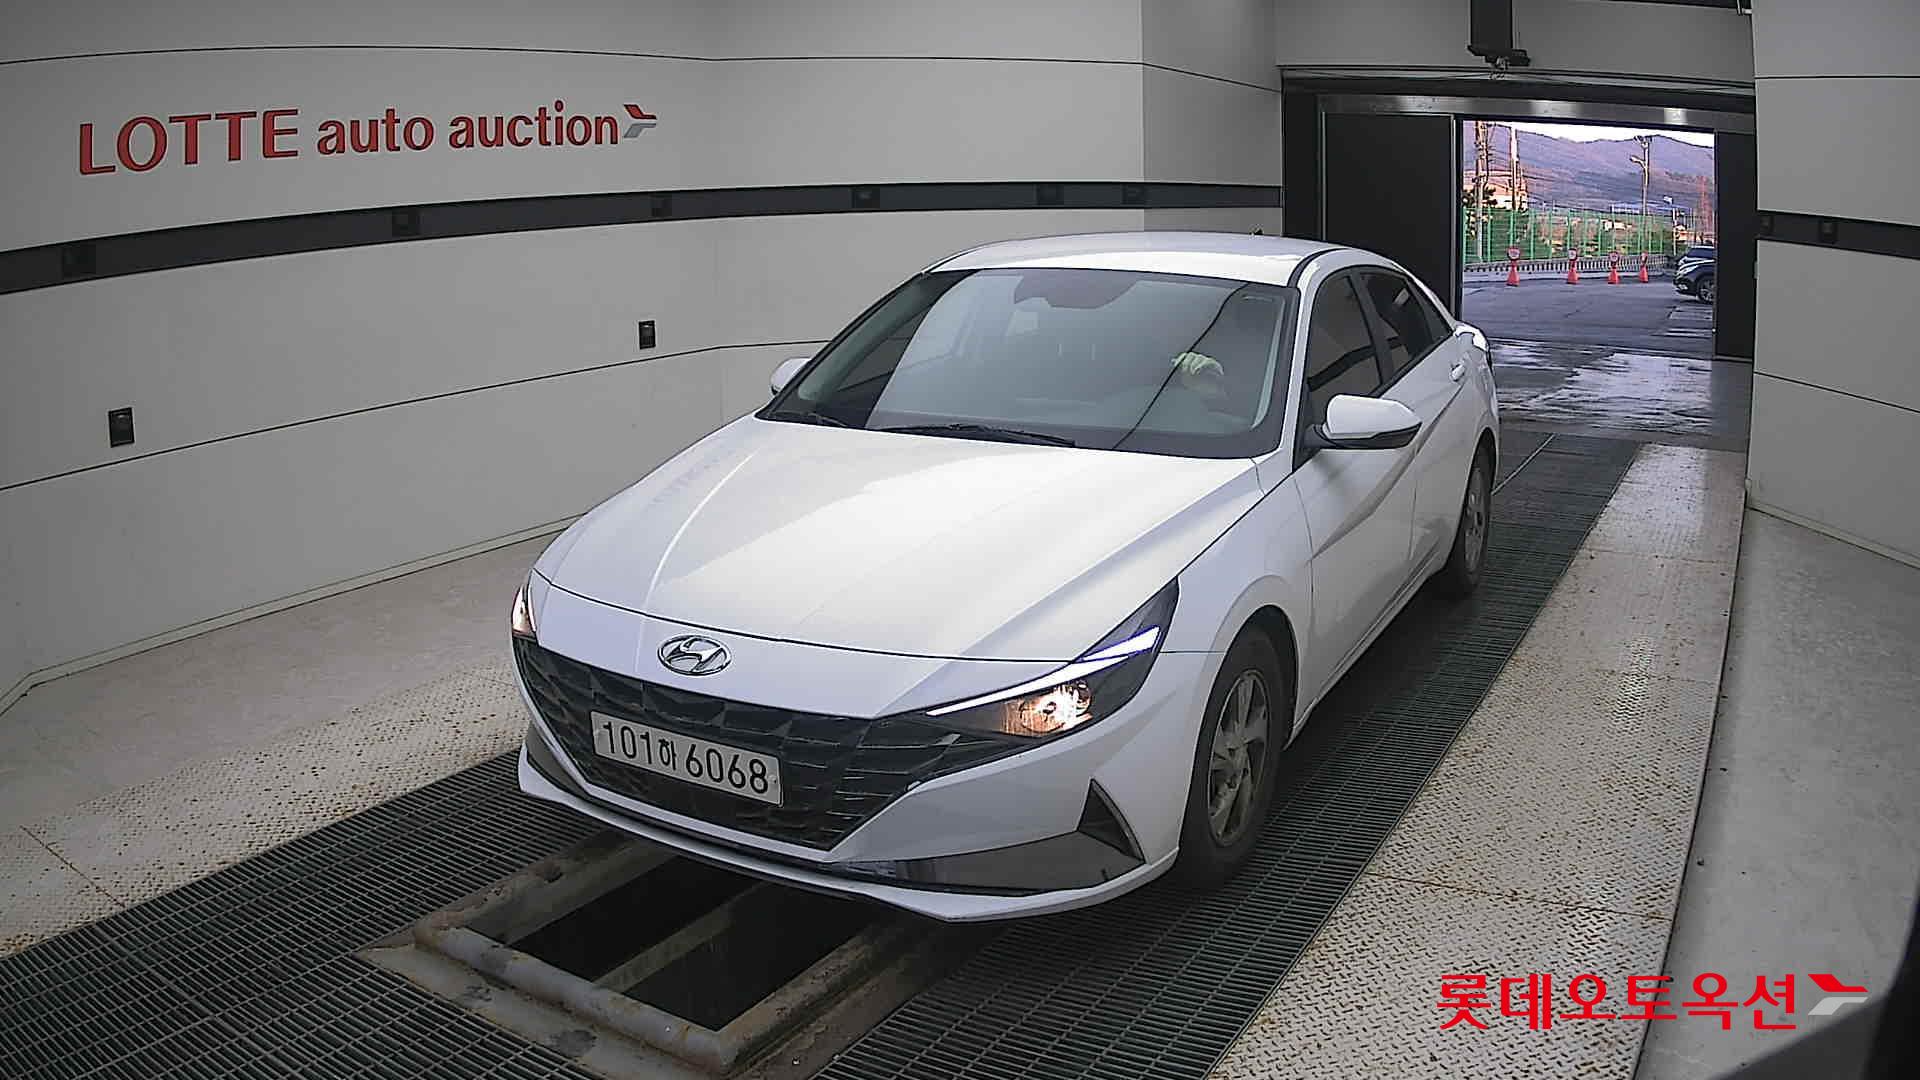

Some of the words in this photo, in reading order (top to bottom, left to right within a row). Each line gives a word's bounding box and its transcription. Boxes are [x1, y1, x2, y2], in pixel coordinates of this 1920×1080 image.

[80, 109, 298, 175] LOTTE
[317, 108, 434, 156] auto
[449, 101, 618, 148] auction
